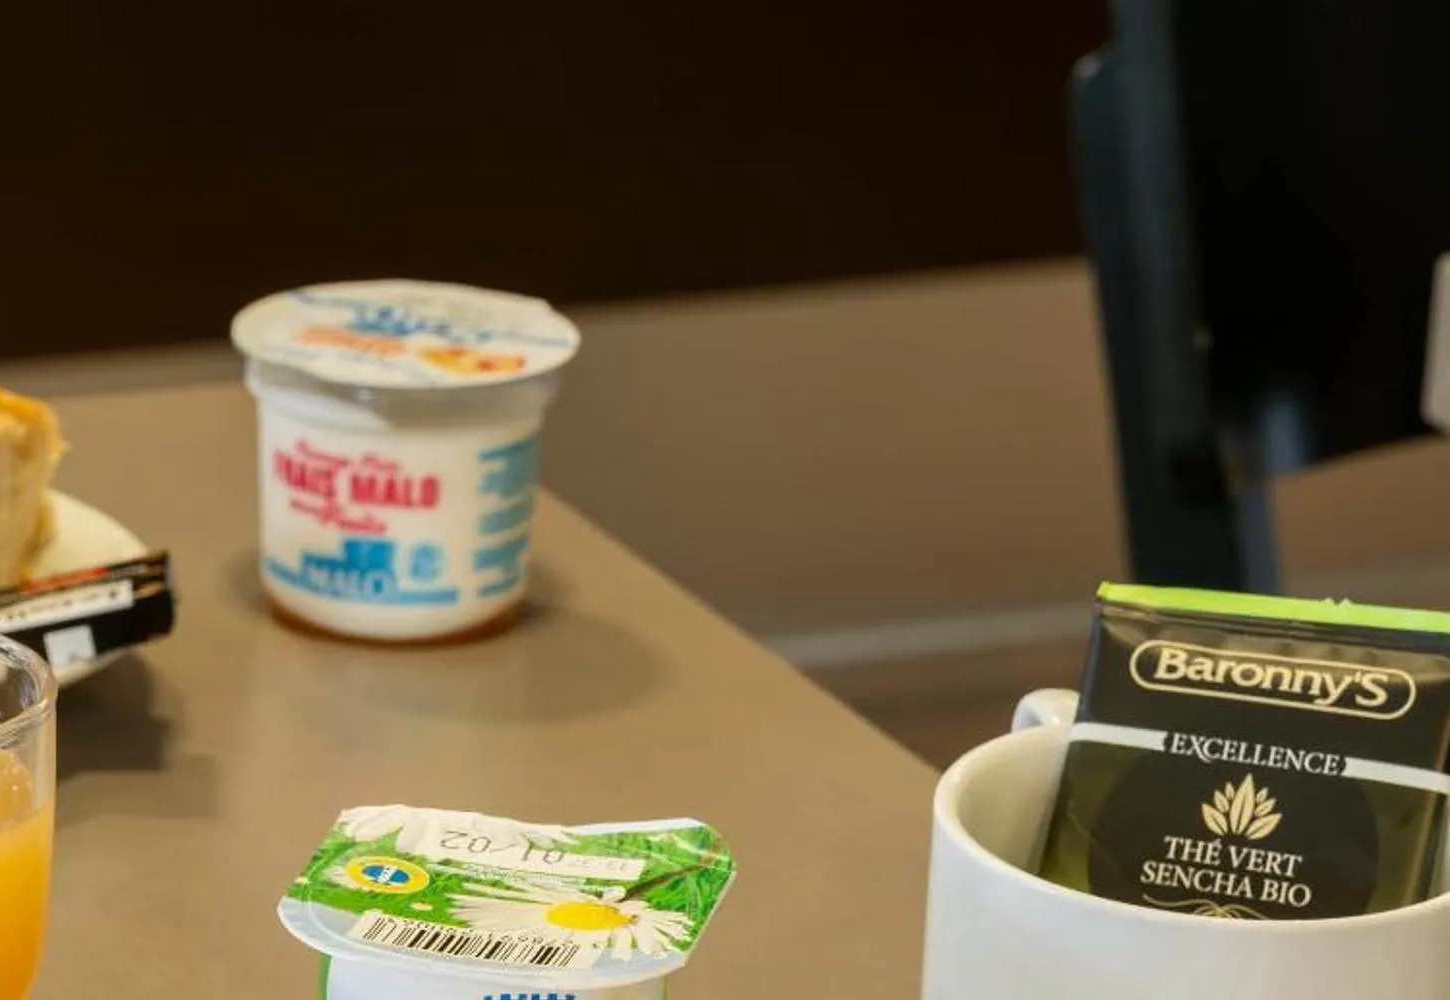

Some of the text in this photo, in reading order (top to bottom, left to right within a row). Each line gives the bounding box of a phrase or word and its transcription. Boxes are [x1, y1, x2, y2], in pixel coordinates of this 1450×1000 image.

[1169, 732, 1341, 776] EXCELLENCE
[1163, 835, 1303, 878] THÉ VERT
[1140, 860, 1312, 908] SENCHA BIO
